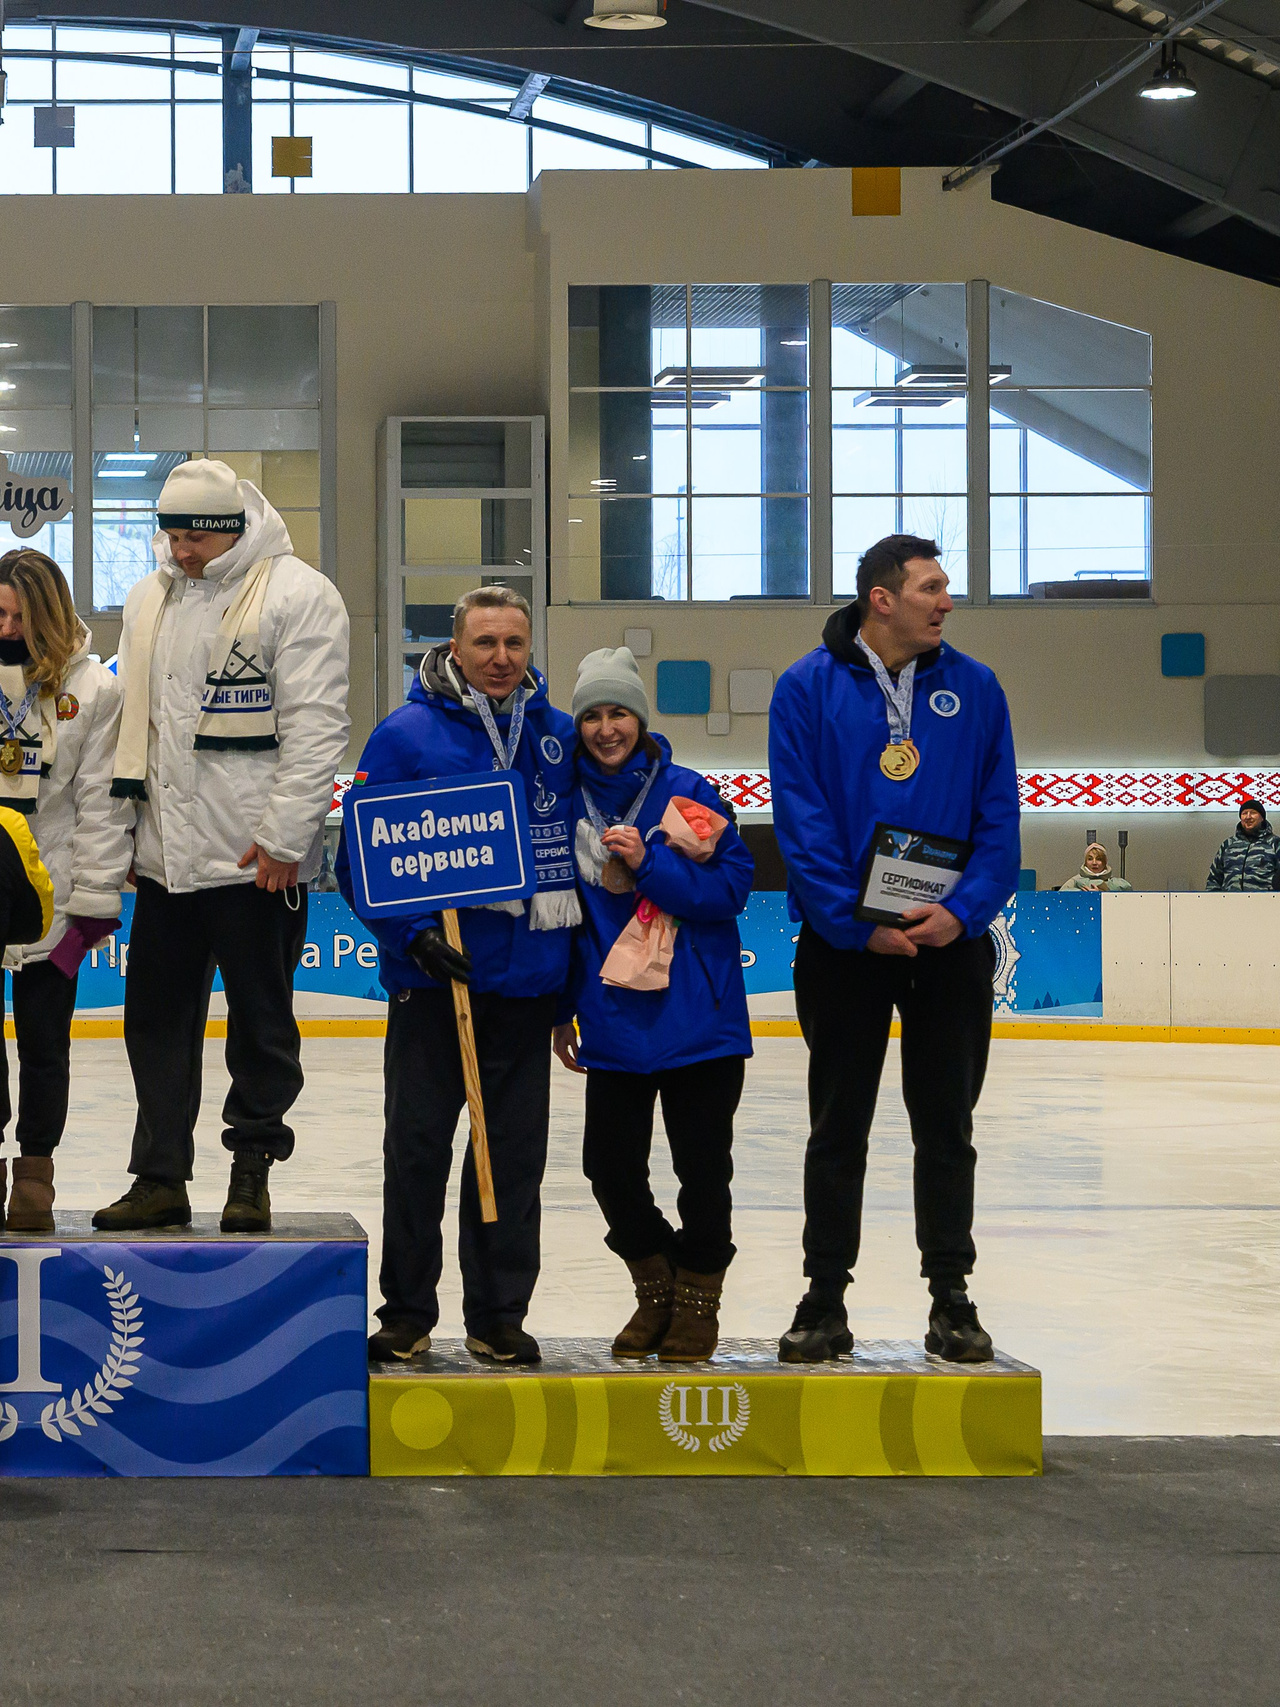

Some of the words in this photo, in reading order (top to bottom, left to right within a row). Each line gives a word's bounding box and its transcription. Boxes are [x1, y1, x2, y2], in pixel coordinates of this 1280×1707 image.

[192, 518, 241, 529] БЕЛАРУСЬ
[371, 809, 505, 848] Академия
[390, 845, 494, 883] сервиса
[535, 845, 570, 859] СЕРВИС
[881, 871, 946, 896] СЕРТИФИКАТ
[676, 1386, 735, 1427] III
